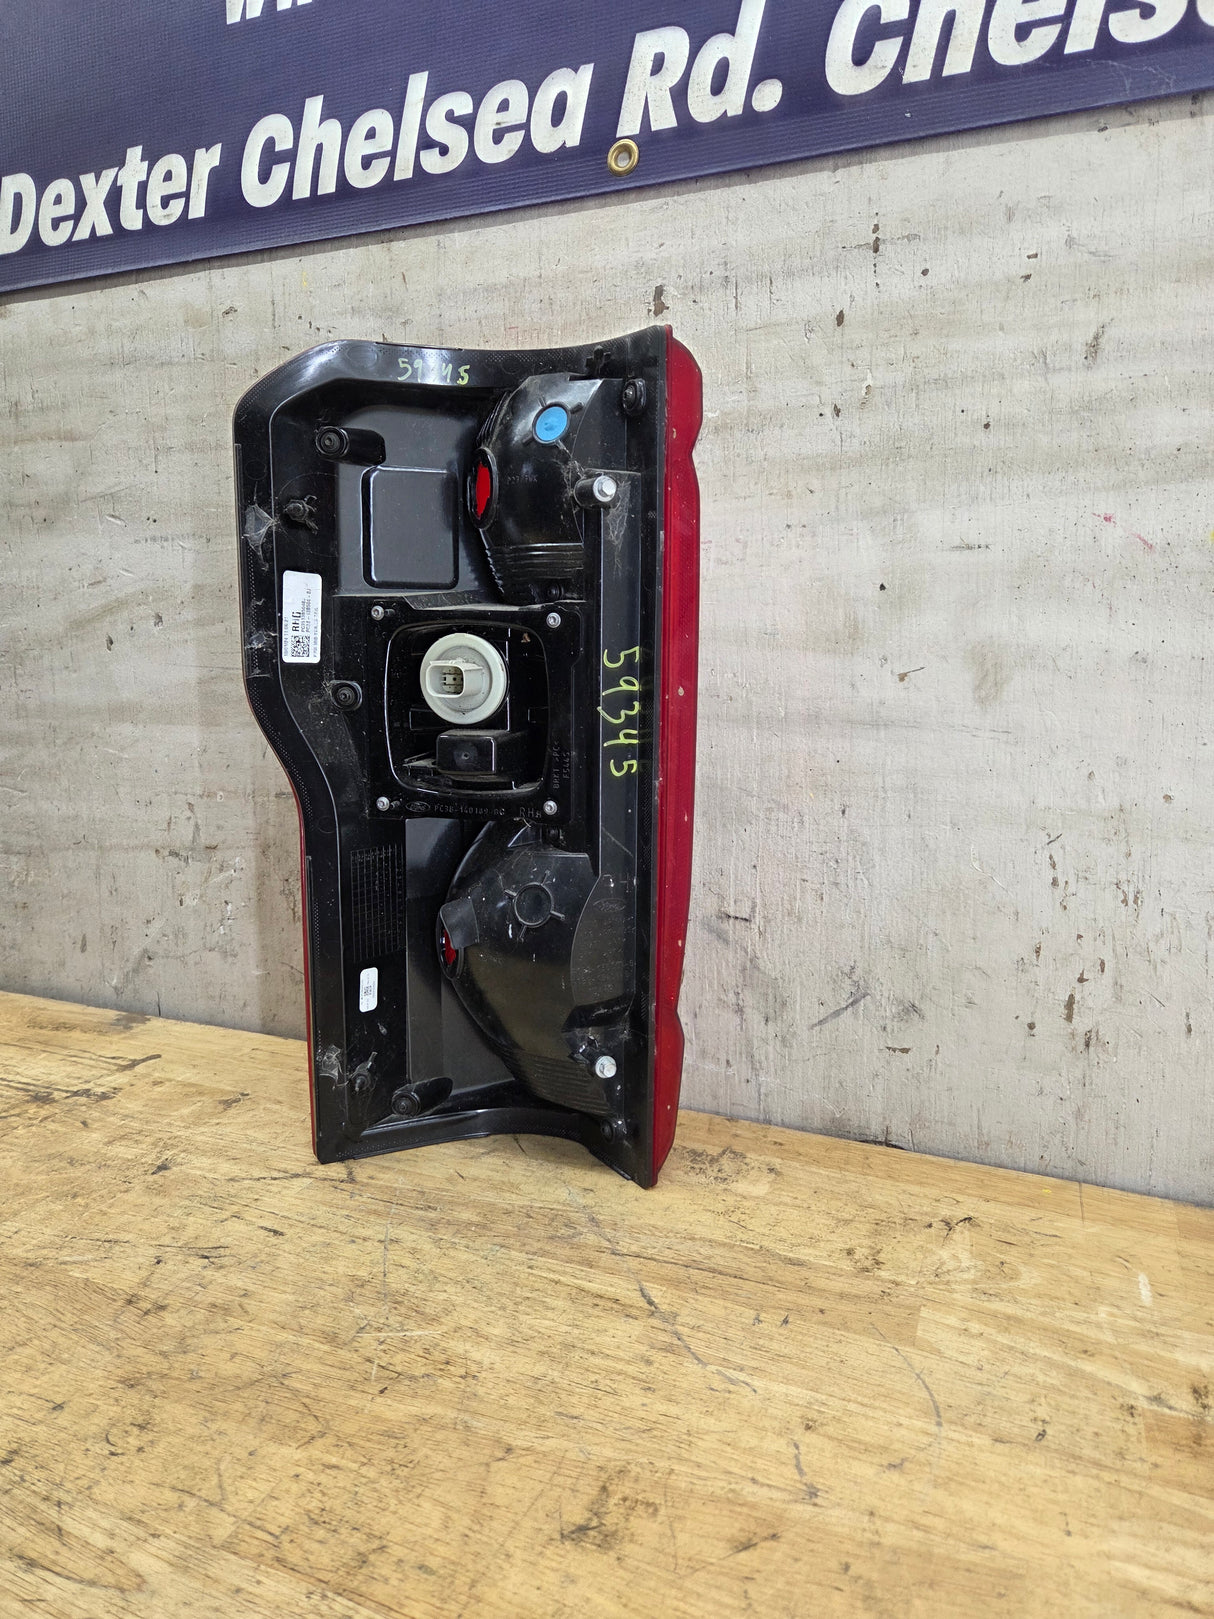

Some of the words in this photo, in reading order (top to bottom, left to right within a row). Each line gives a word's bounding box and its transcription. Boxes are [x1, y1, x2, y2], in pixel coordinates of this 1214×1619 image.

[0, 143, 222, 256] Dexter
[240, 62, 595, 208] Chelsea
[616, 0, 783, 138] Rd.
[597, 646, 640, 777] 59345
